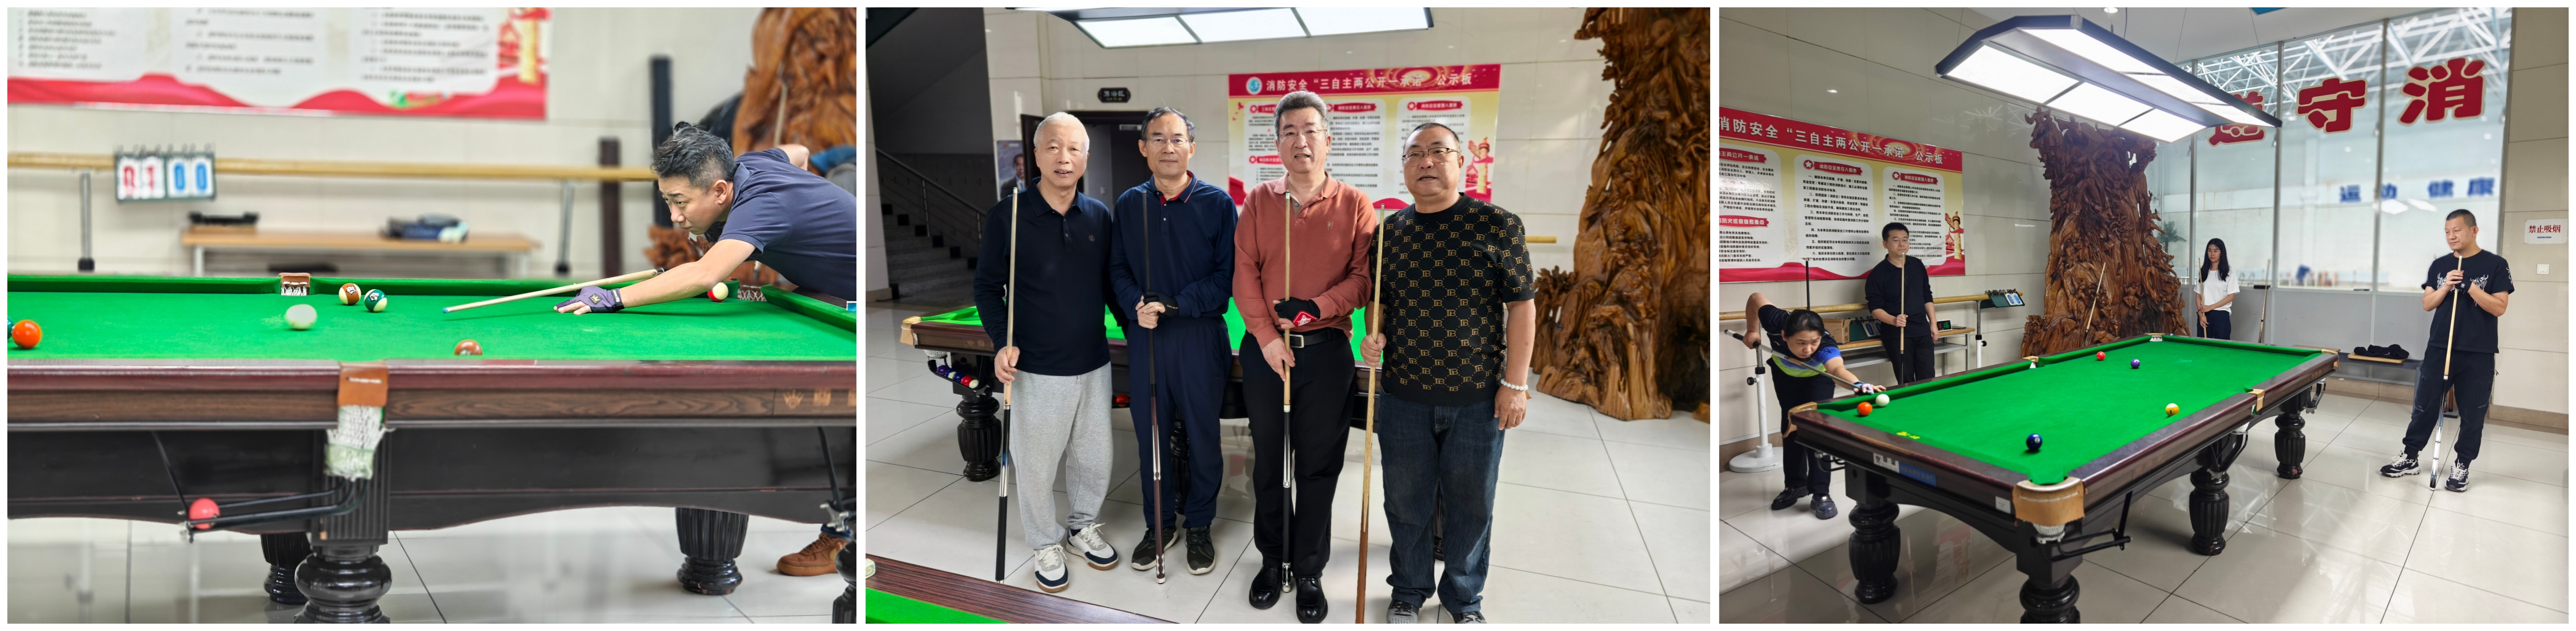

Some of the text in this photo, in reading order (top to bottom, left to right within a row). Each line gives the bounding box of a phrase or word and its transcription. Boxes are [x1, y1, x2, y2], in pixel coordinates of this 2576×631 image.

[1266, 79, 1308, 91] 消防安全
[1437, 73, 1472, 86] 公示板
[1914, 151, 1943, 165] 公示板
[1819, 164, 1857, 173] 消防安全责任人职责
[2428, 177, 2496, 199] 健康
[2528, 225, 2561, 233] 禁止吸烟
